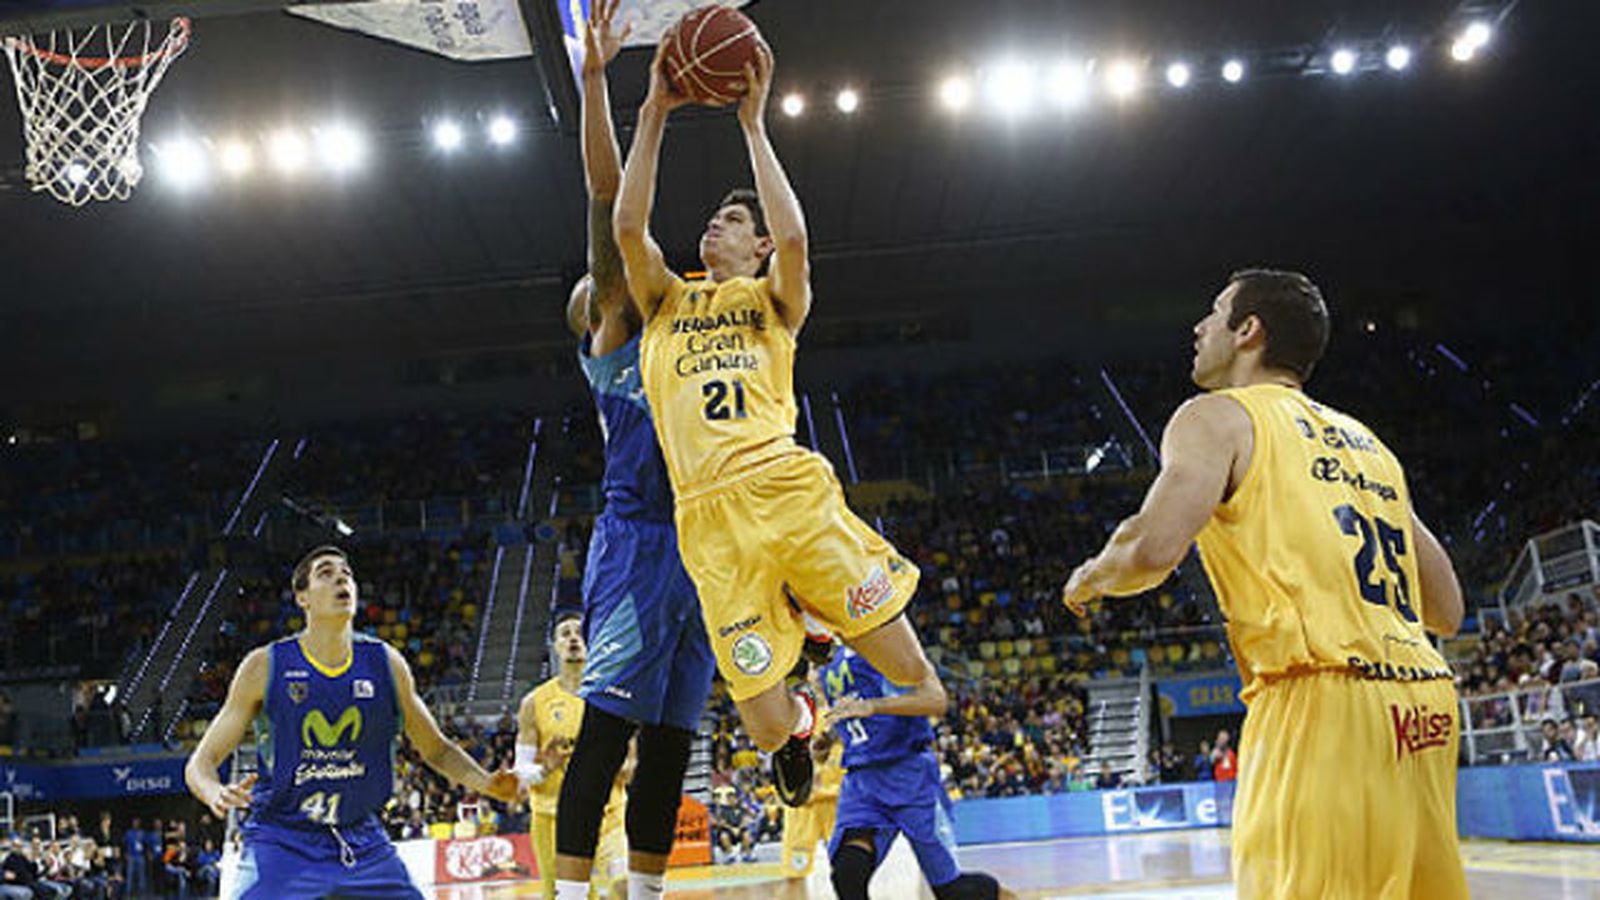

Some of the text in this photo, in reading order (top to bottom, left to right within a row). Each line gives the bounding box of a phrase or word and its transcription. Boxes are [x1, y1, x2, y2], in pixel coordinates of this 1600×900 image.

[686, 332, 745, 354] Gran
[701, 379, 748, 421] 21
[1332, 503, 1419, 623] 25
[300, 790, 341, 825] 41
